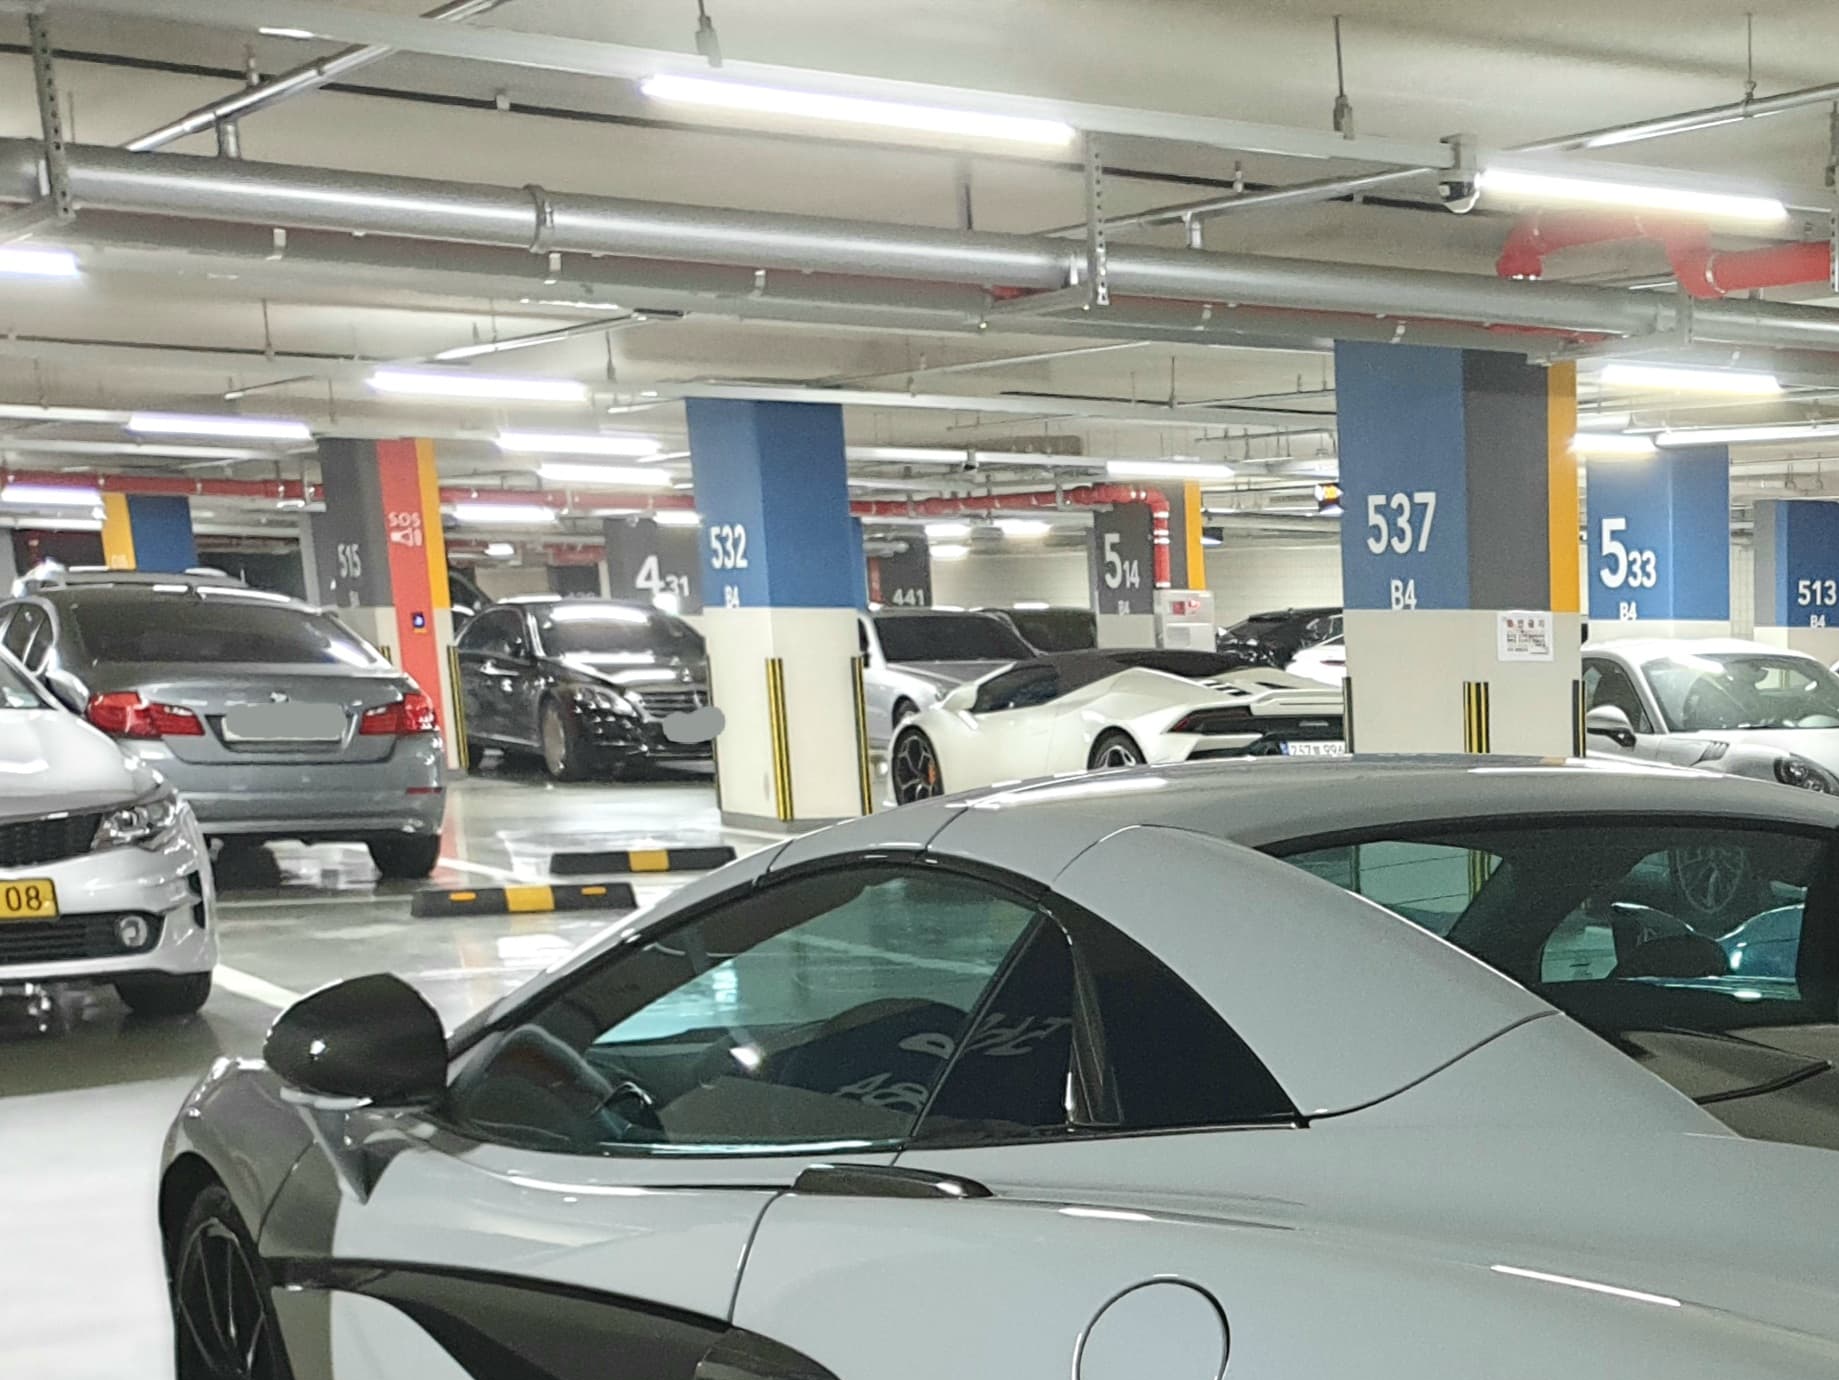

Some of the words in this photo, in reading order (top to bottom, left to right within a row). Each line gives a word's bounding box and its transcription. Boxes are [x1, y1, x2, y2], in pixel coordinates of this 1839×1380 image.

[388, 511, 421, 527] SOS
[1366, 491, 1437, 554] 537
[710, 524, 749, 569] 532
[1599, 517, 1657, 588] 533
[1104, 532, 1140, 589] 514
[892, 588, 925, 606] 441
[1390, 579, 1417, 610] B4
[1797, 580, 1837, 606] 513
[1619, 601, 1637, 621] B4
[1810, 614, 1826, 628] B4
[5, 885, 42, 912] 08
